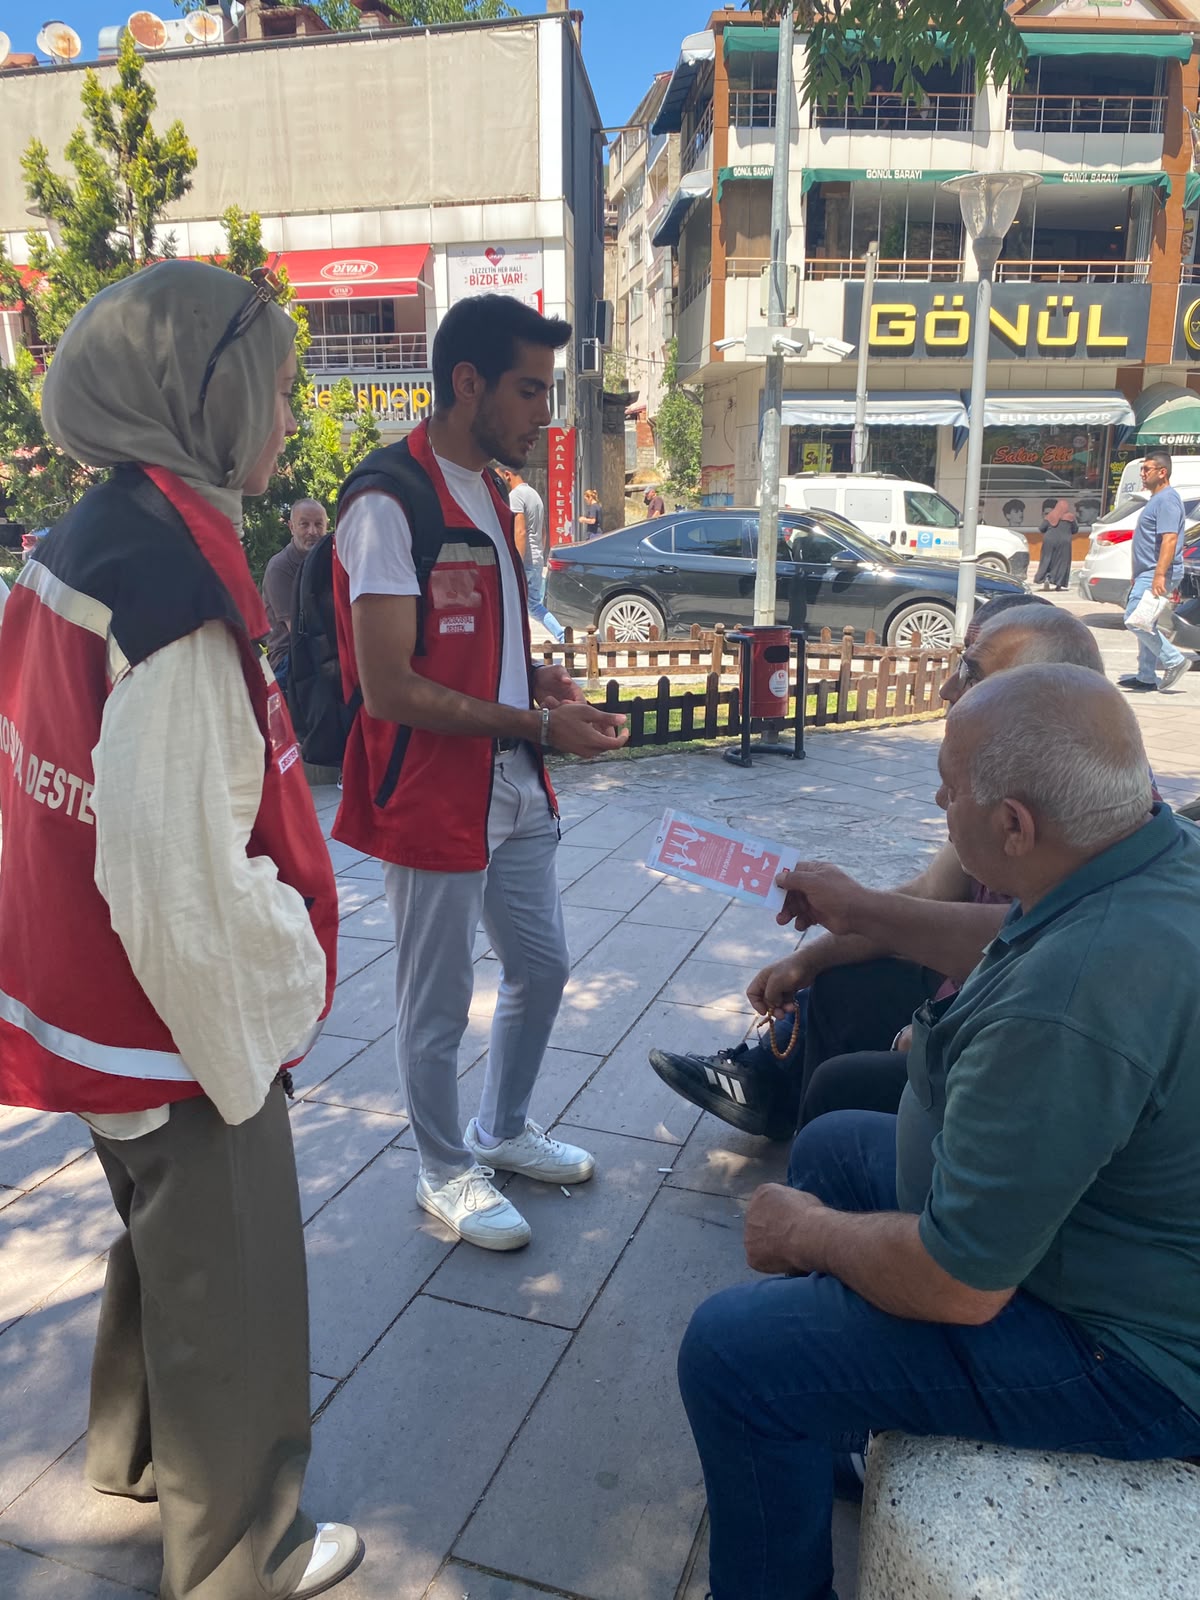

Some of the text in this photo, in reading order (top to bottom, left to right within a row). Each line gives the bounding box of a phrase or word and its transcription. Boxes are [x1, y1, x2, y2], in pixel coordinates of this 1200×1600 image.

[894, 169, 922, 179] SARAYI
[1090, 173, 1118, 183] SARAYI
[332, 263, 368, 273] DİVAN
[469, 272, 523, 286] BİZDE VAR!
[868, 295, 1128, 347] GÖNÜL
[357, 383, 431, 413] shop
[555, 435, 566, 470] PALA
[992, 446, 1038, 464] Salon
